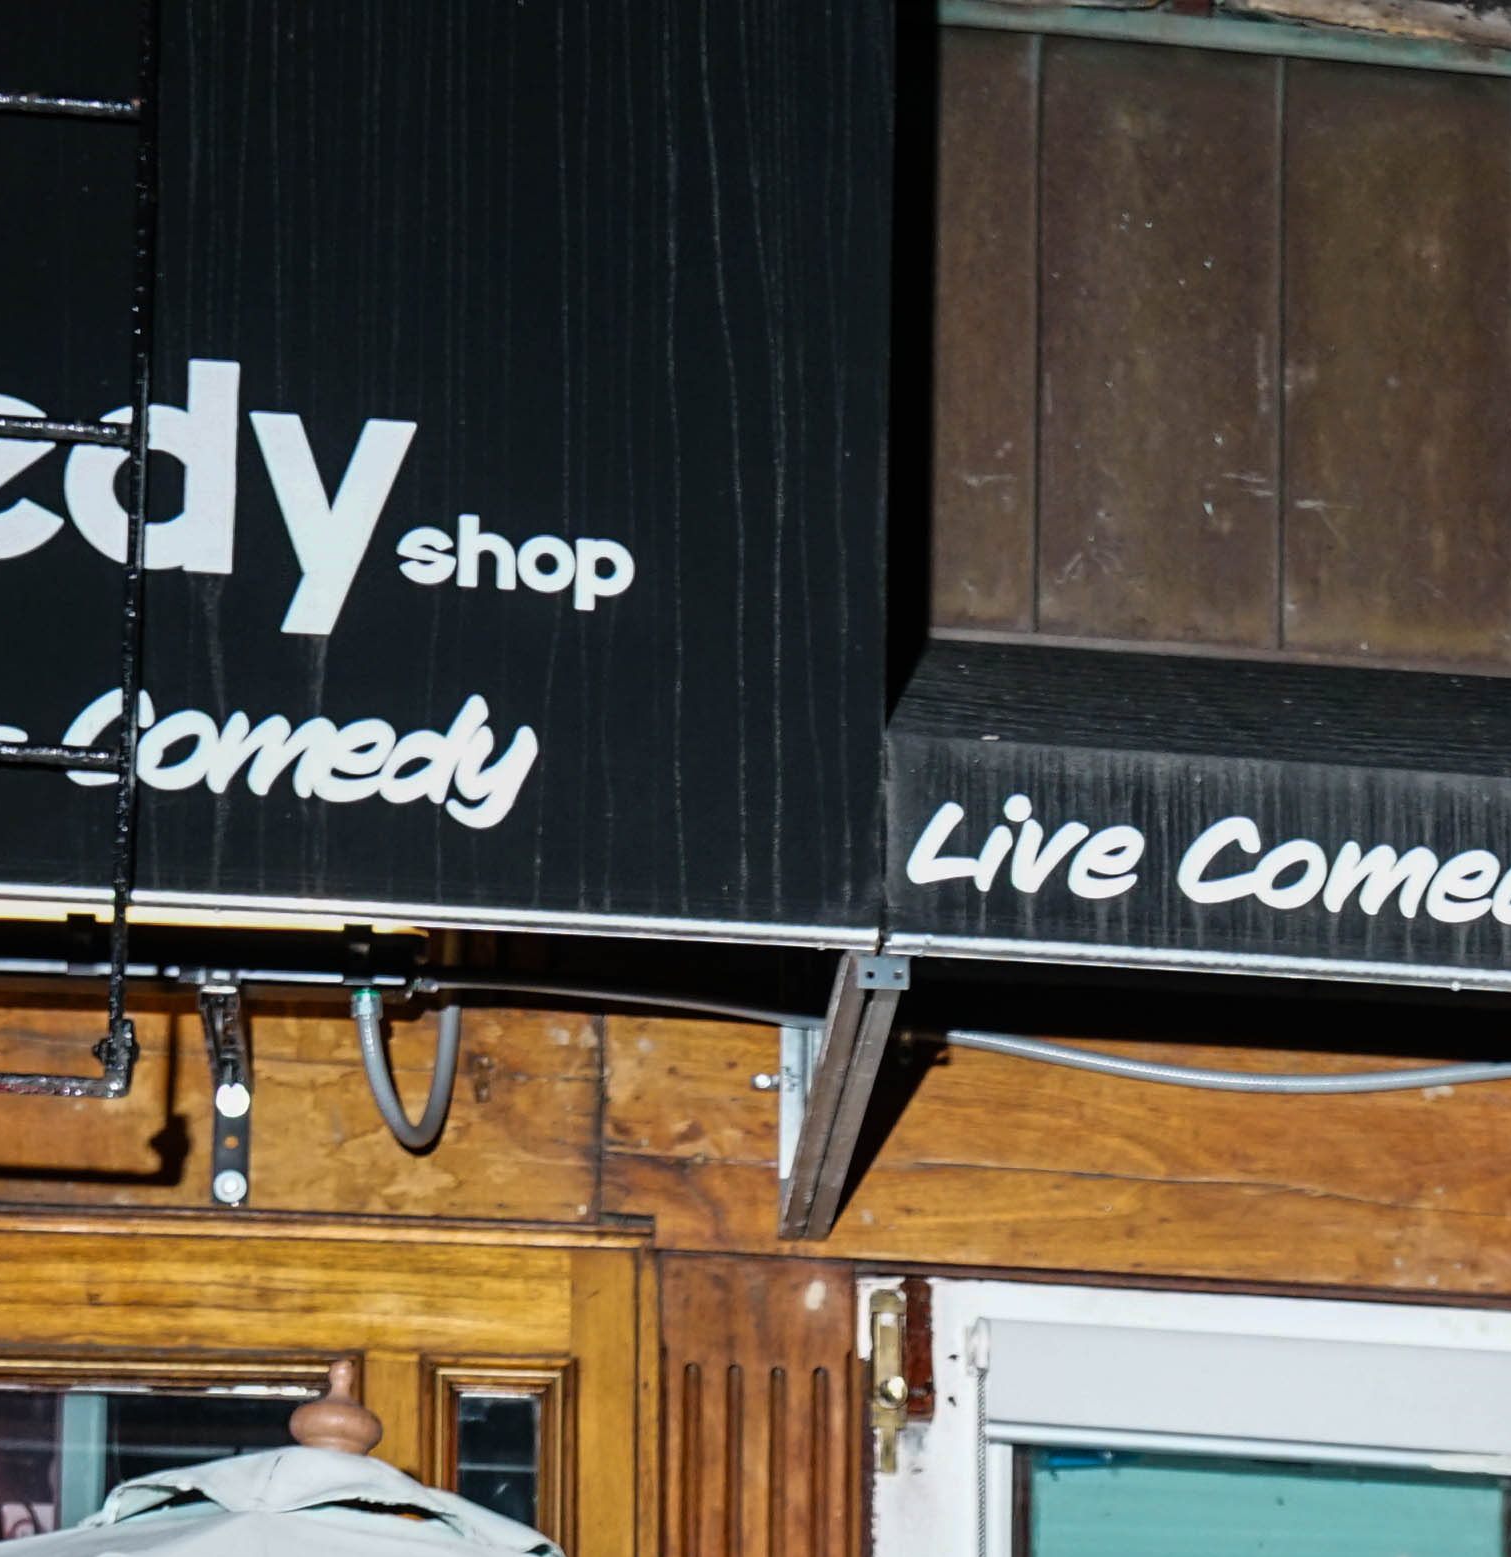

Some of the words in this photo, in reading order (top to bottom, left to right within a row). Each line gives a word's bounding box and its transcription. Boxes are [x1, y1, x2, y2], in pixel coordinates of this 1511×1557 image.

[397, 511, 635, 614] shop
[65, 684, 539, 832] Comedy
[905, 792, 1143, 900] Live
